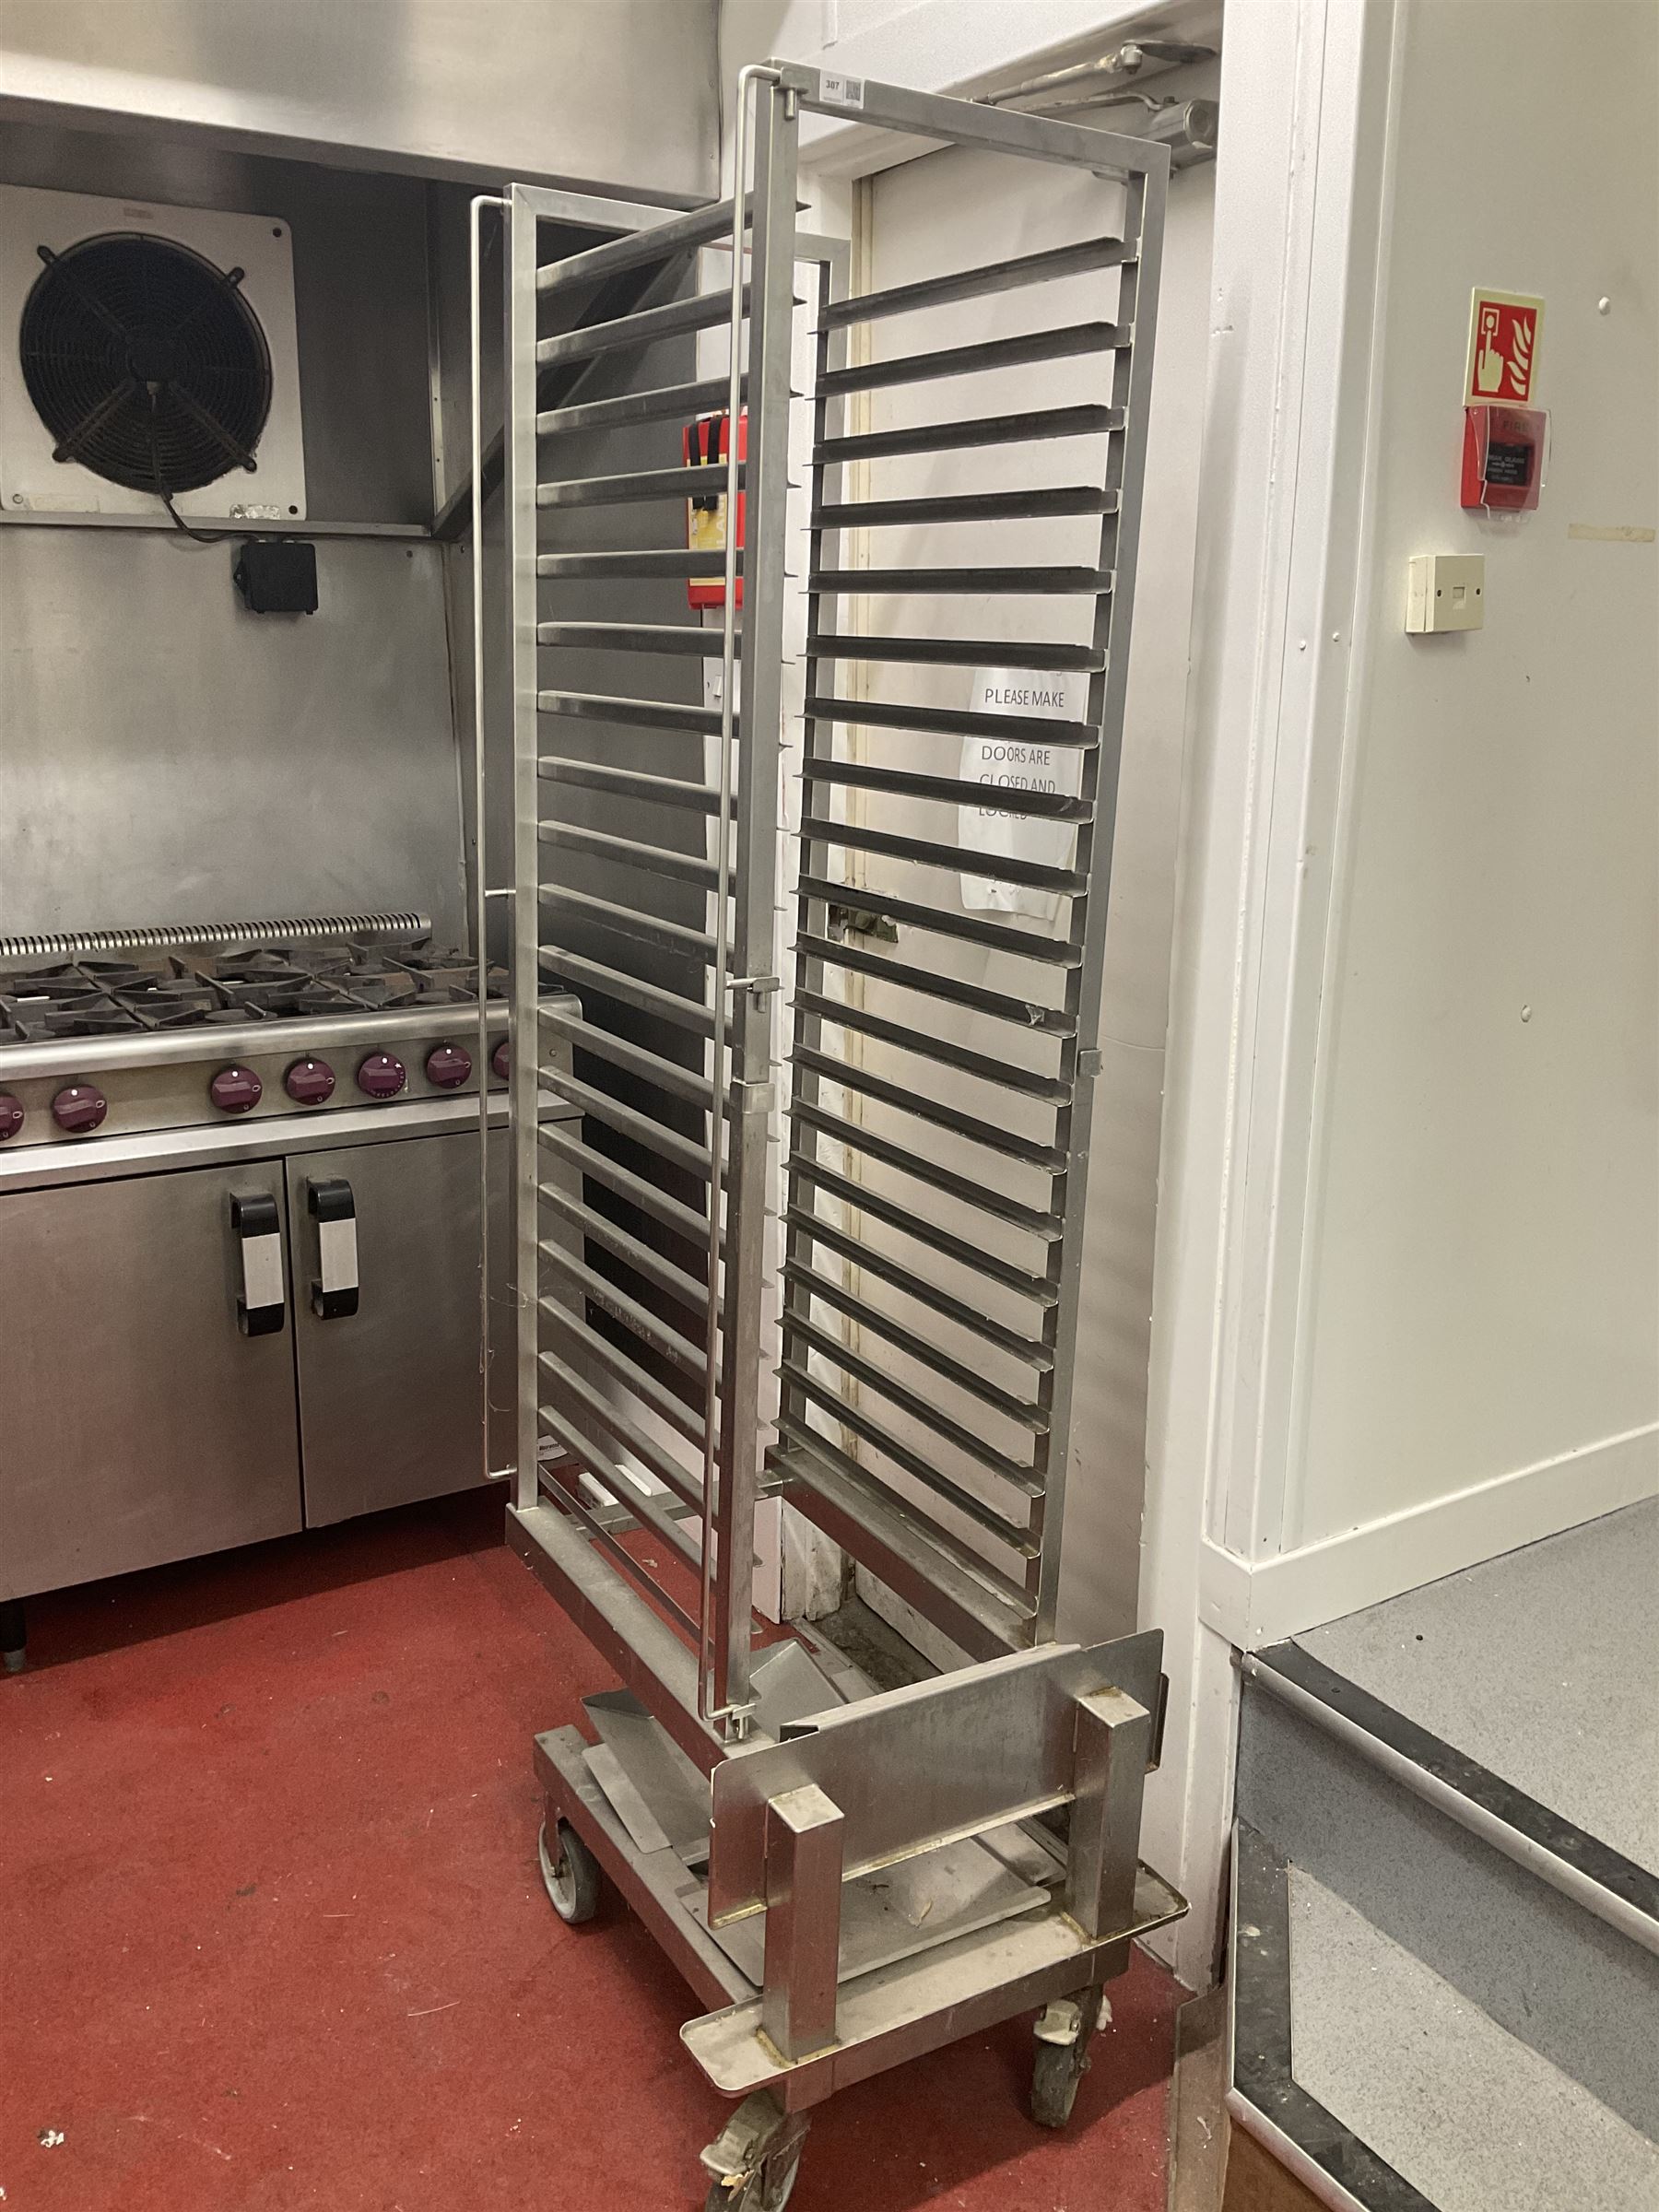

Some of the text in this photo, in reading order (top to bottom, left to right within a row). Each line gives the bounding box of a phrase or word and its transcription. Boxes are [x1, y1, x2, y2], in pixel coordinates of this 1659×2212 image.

[984, 688, 1065, 708] PLEASE MAKE
[982, 746, 1051, 766] DOORS ARE
[1030, 778, 1055, 794] AND
